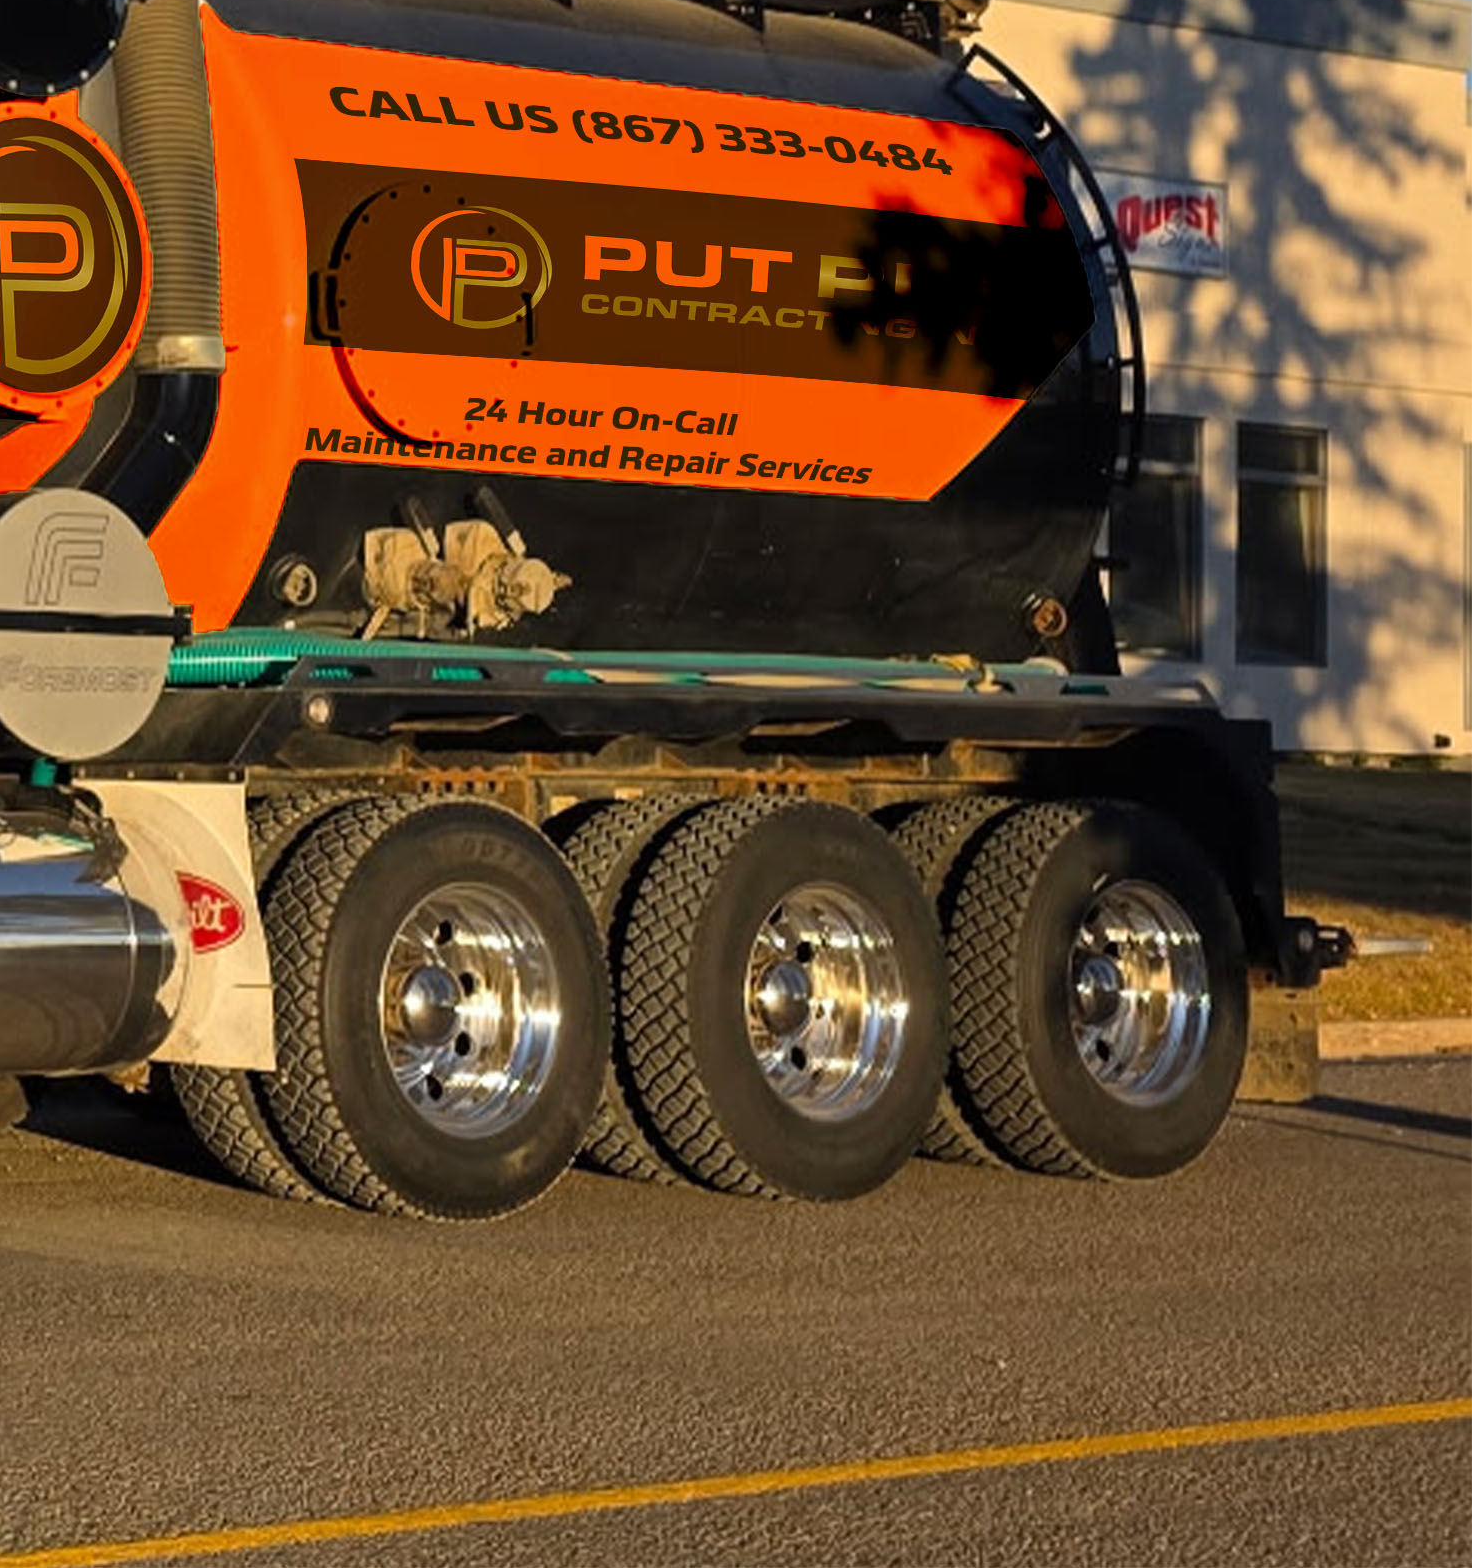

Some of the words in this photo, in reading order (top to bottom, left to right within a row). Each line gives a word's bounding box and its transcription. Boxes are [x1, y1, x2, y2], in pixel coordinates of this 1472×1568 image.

[329, 86, 475, 127] CALL
[485, 100, 558, 135] US
[572, 109, 705, 154] (867)
[719, 124, 953, 175] 333-0484
[584, 234, 793, 293] PUT
[581, 293, 917, 341] CONTRACTNG
[464, 397, 508, 424] 24
[517, 400, 603, 429] Hour
[612, 405, 739, 437] On-Call
[304, 427, 537, 465] Maintenance
[546, 442, 610, 470] and
[619, 447, 729, 479] Repair
[736, 454, 873, 485] Services
